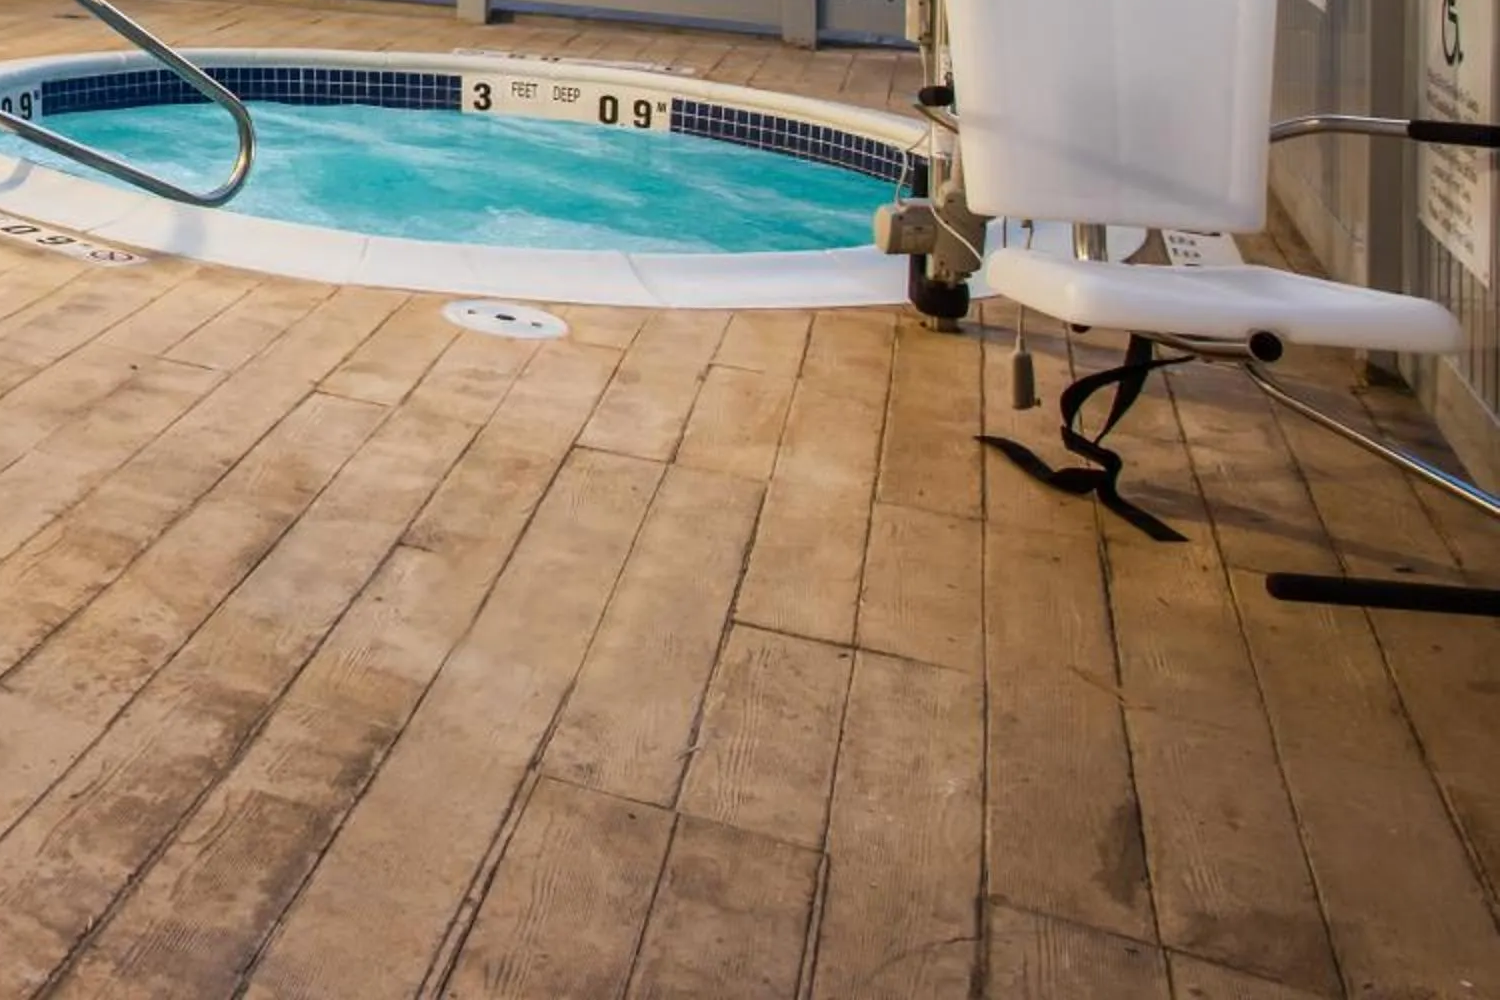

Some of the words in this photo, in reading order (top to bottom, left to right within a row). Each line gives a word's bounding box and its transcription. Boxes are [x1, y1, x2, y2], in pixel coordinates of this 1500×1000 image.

[473, 82, 492, 111] 3
[510, 81, 538, 99] FEET
[553, 85, 580, 103] DEEP
